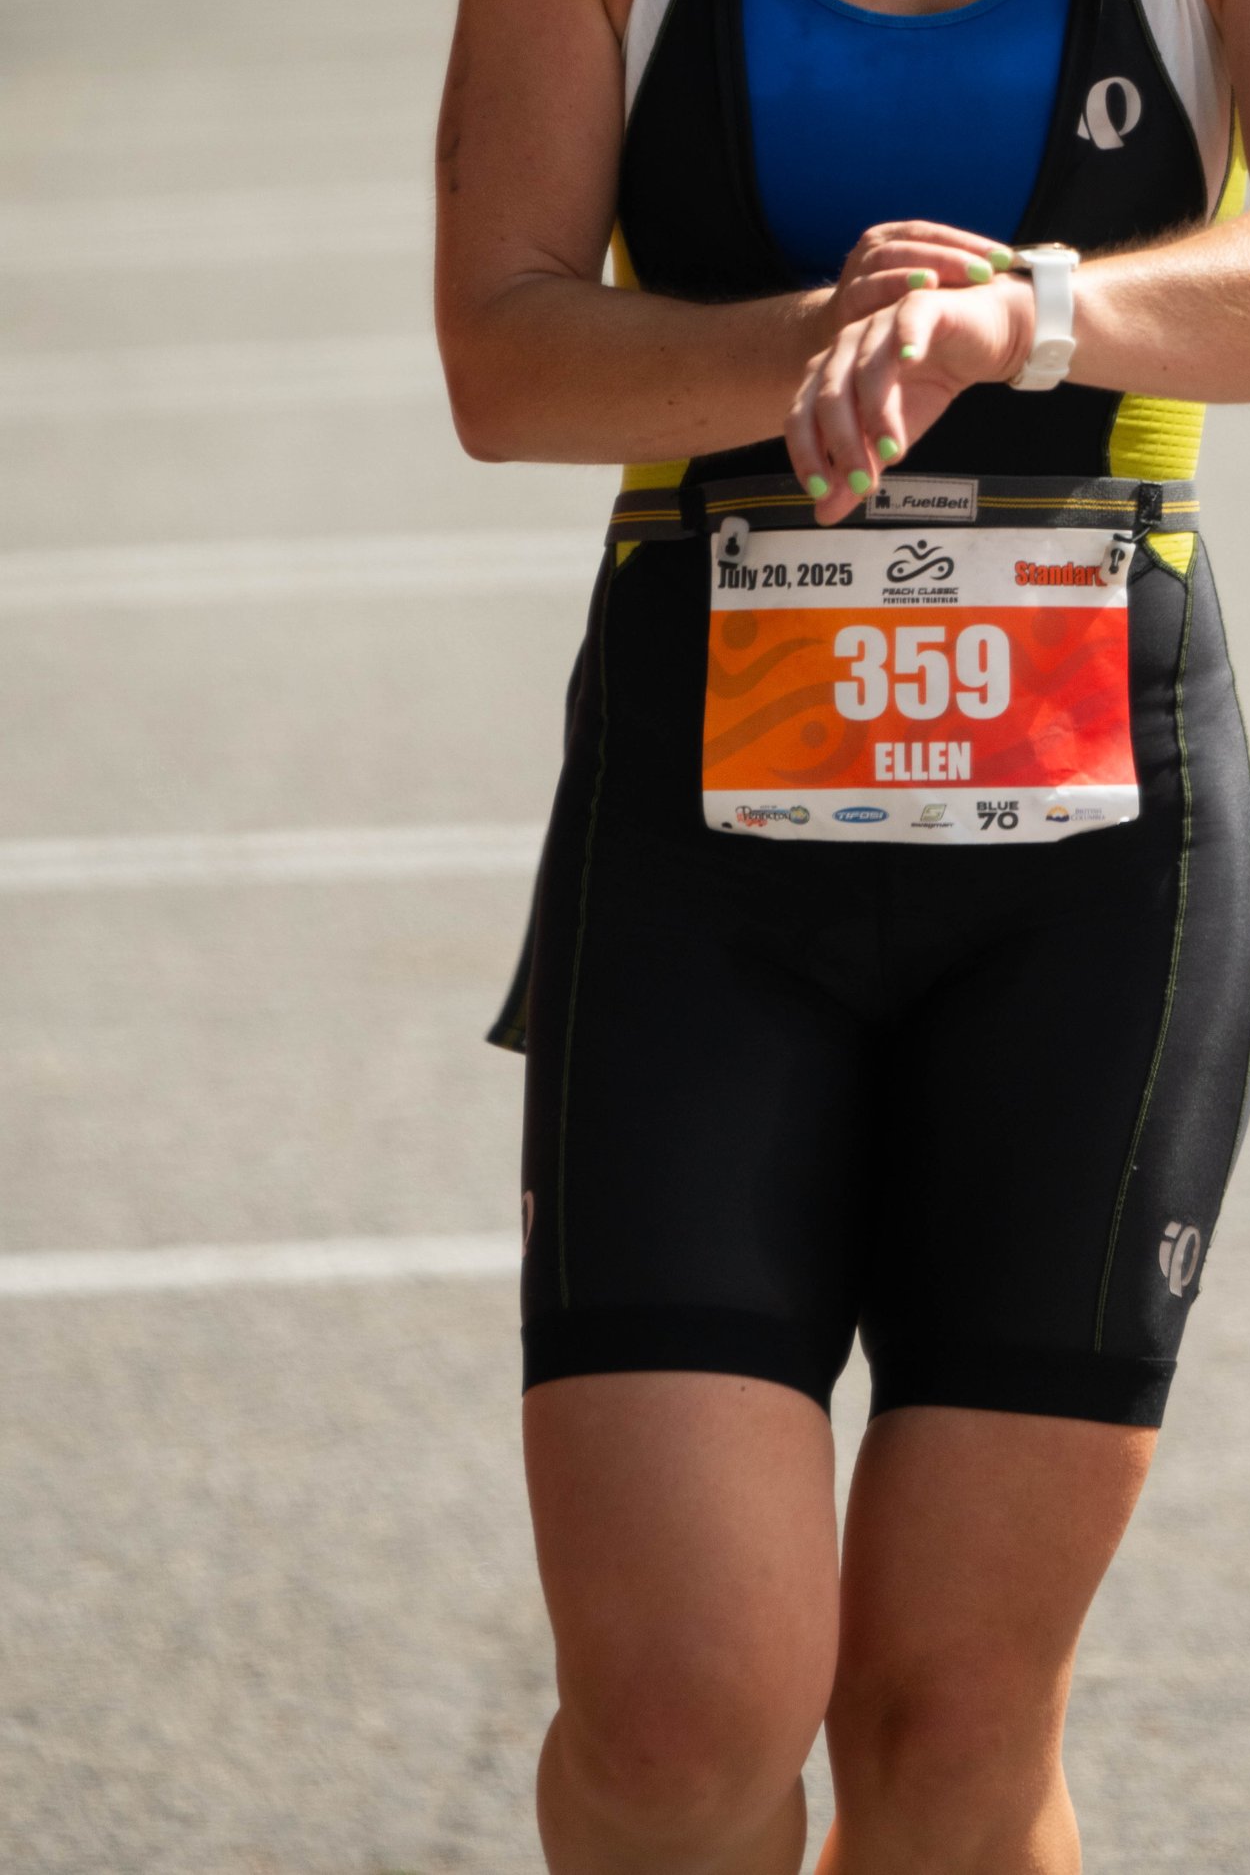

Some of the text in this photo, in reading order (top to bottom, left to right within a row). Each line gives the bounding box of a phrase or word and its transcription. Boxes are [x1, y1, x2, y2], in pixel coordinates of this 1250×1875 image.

[902, 495, 969, 509] FuelBelt
[718, 563, 853, 591] July 20, 2025
[918, 587, 959, 595] CLASSIC
[834, 624, 1010, 721] 359
[875, 741, 971, 781] ELLEN
[976, 801, 1020, 811] BLUE
[838, 811, 884, 820] TIFOSI
[977, 811, 1019, 831] 70
